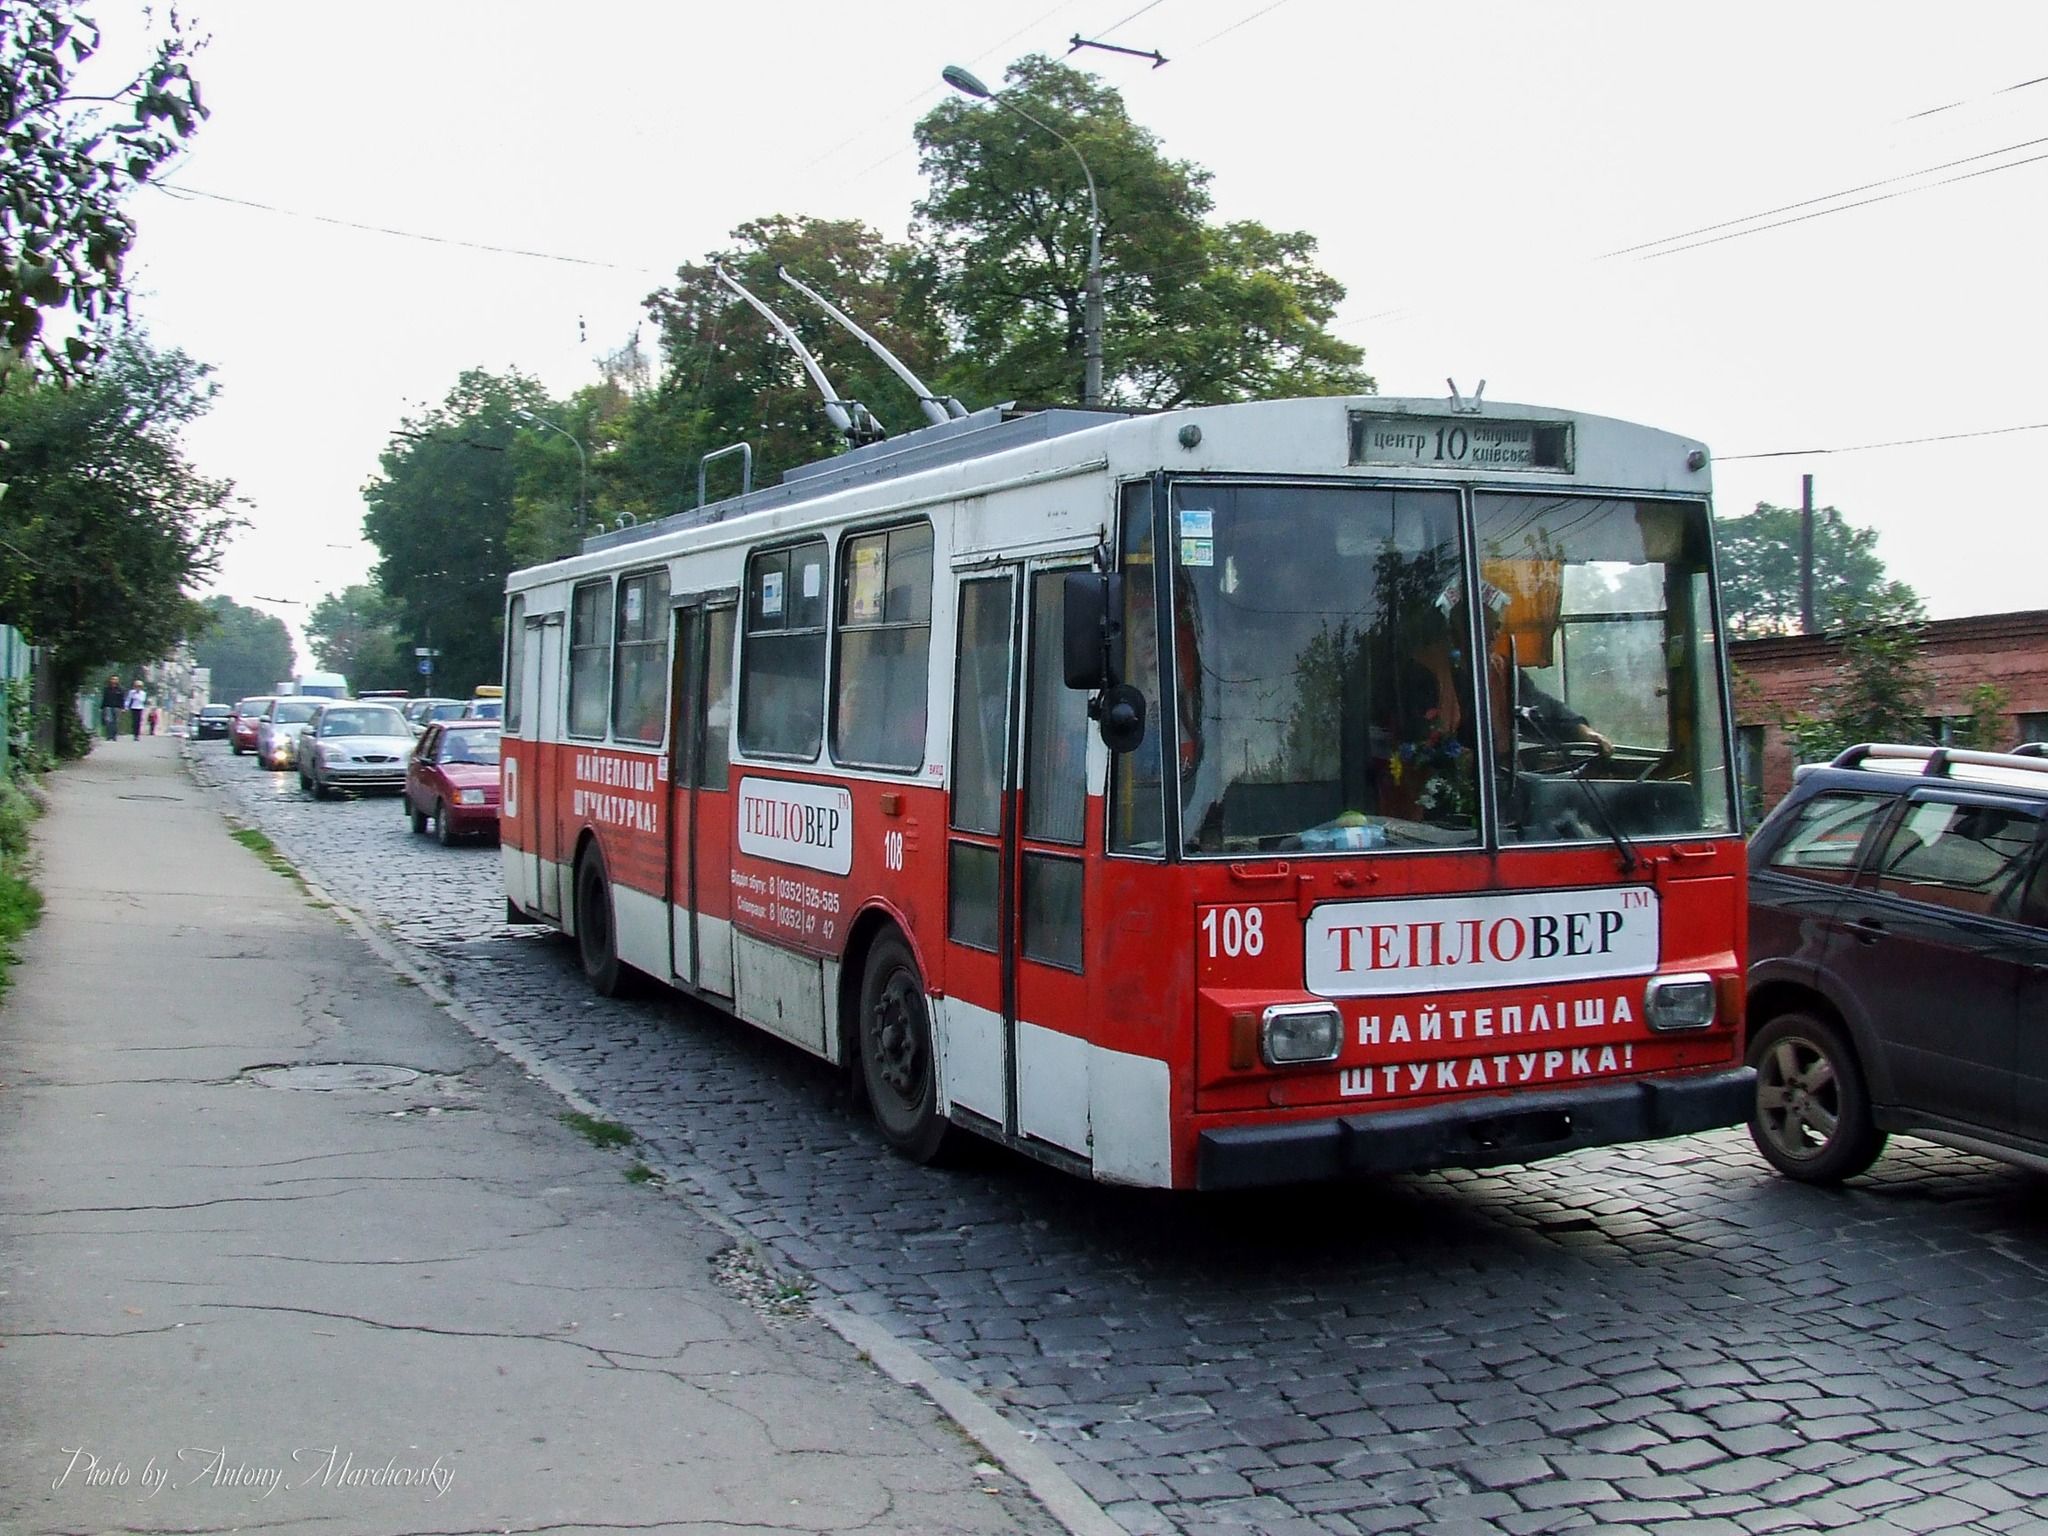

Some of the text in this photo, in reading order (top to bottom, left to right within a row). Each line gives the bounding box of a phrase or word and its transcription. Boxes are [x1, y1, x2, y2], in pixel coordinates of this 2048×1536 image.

[1374, 432, 1426, 458] центр
[1434, 426, 1468, 460] 10
[576, 748, 654, 793] НАЙТЕПЛІША
[574, 789, 657, 834] ШТУКАТУРКА!
[744, 796, 840, 849] ТЕПЛОВЕР
[884, 830, 904, 871] 108
[1201, 906, 1265, 958] 108
[1326, 910, 1624, 973] ТЕПЛОВЕР
[1358, 995, 1634, 1046] НАЙТЕПЛІША
[1339, 1044, 1634, 1097] ШТУКАТУРКА!
